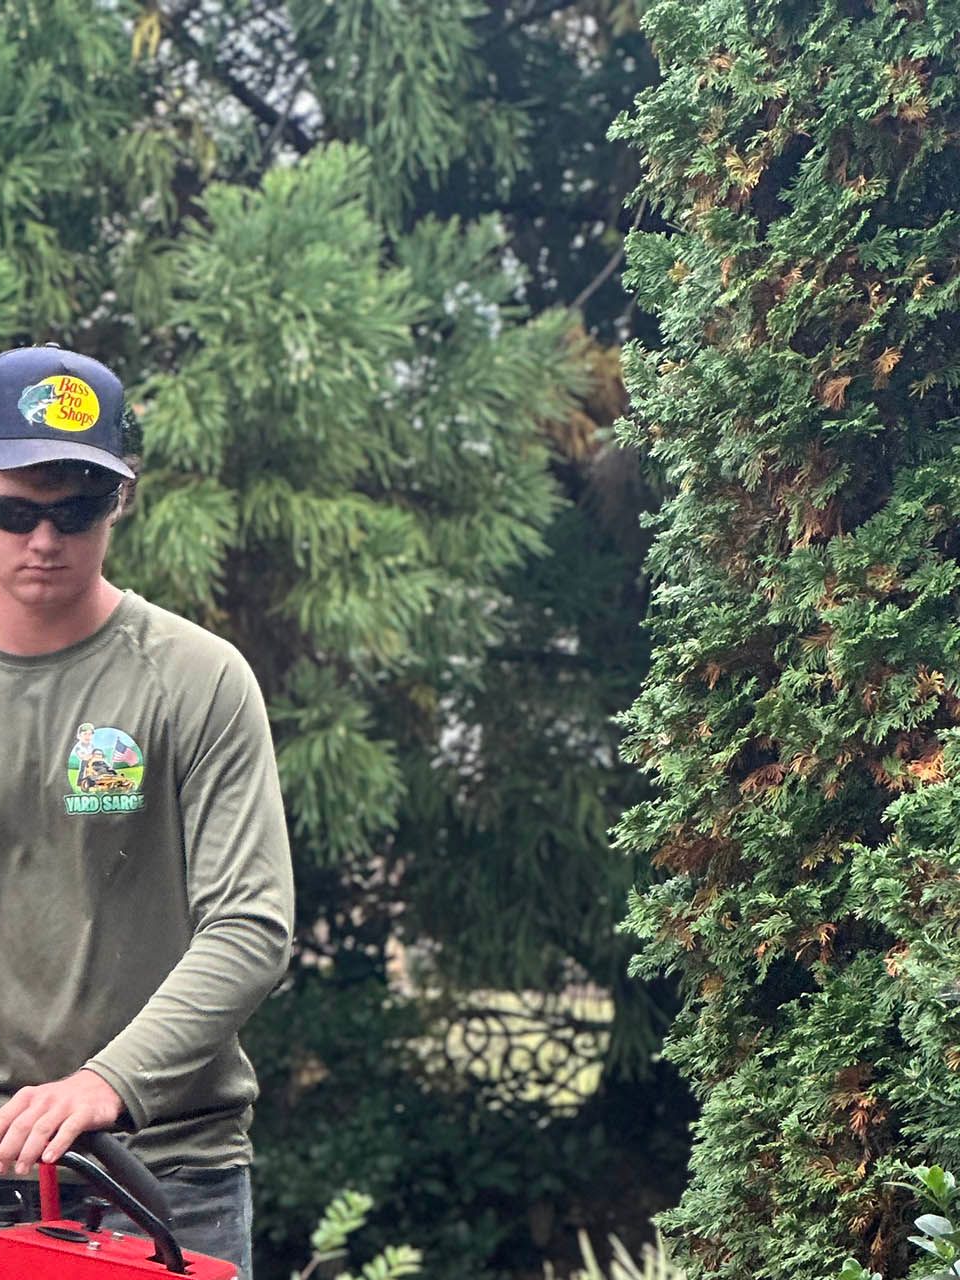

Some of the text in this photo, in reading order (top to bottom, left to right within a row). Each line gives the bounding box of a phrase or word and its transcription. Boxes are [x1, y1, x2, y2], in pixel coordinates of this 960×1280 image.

[59, 377, 89, 396] Bass
[59, 392, 82, 408] Pro
[57, 405, 95, 426] Shops
[65, 796, 99, 812] YARD
